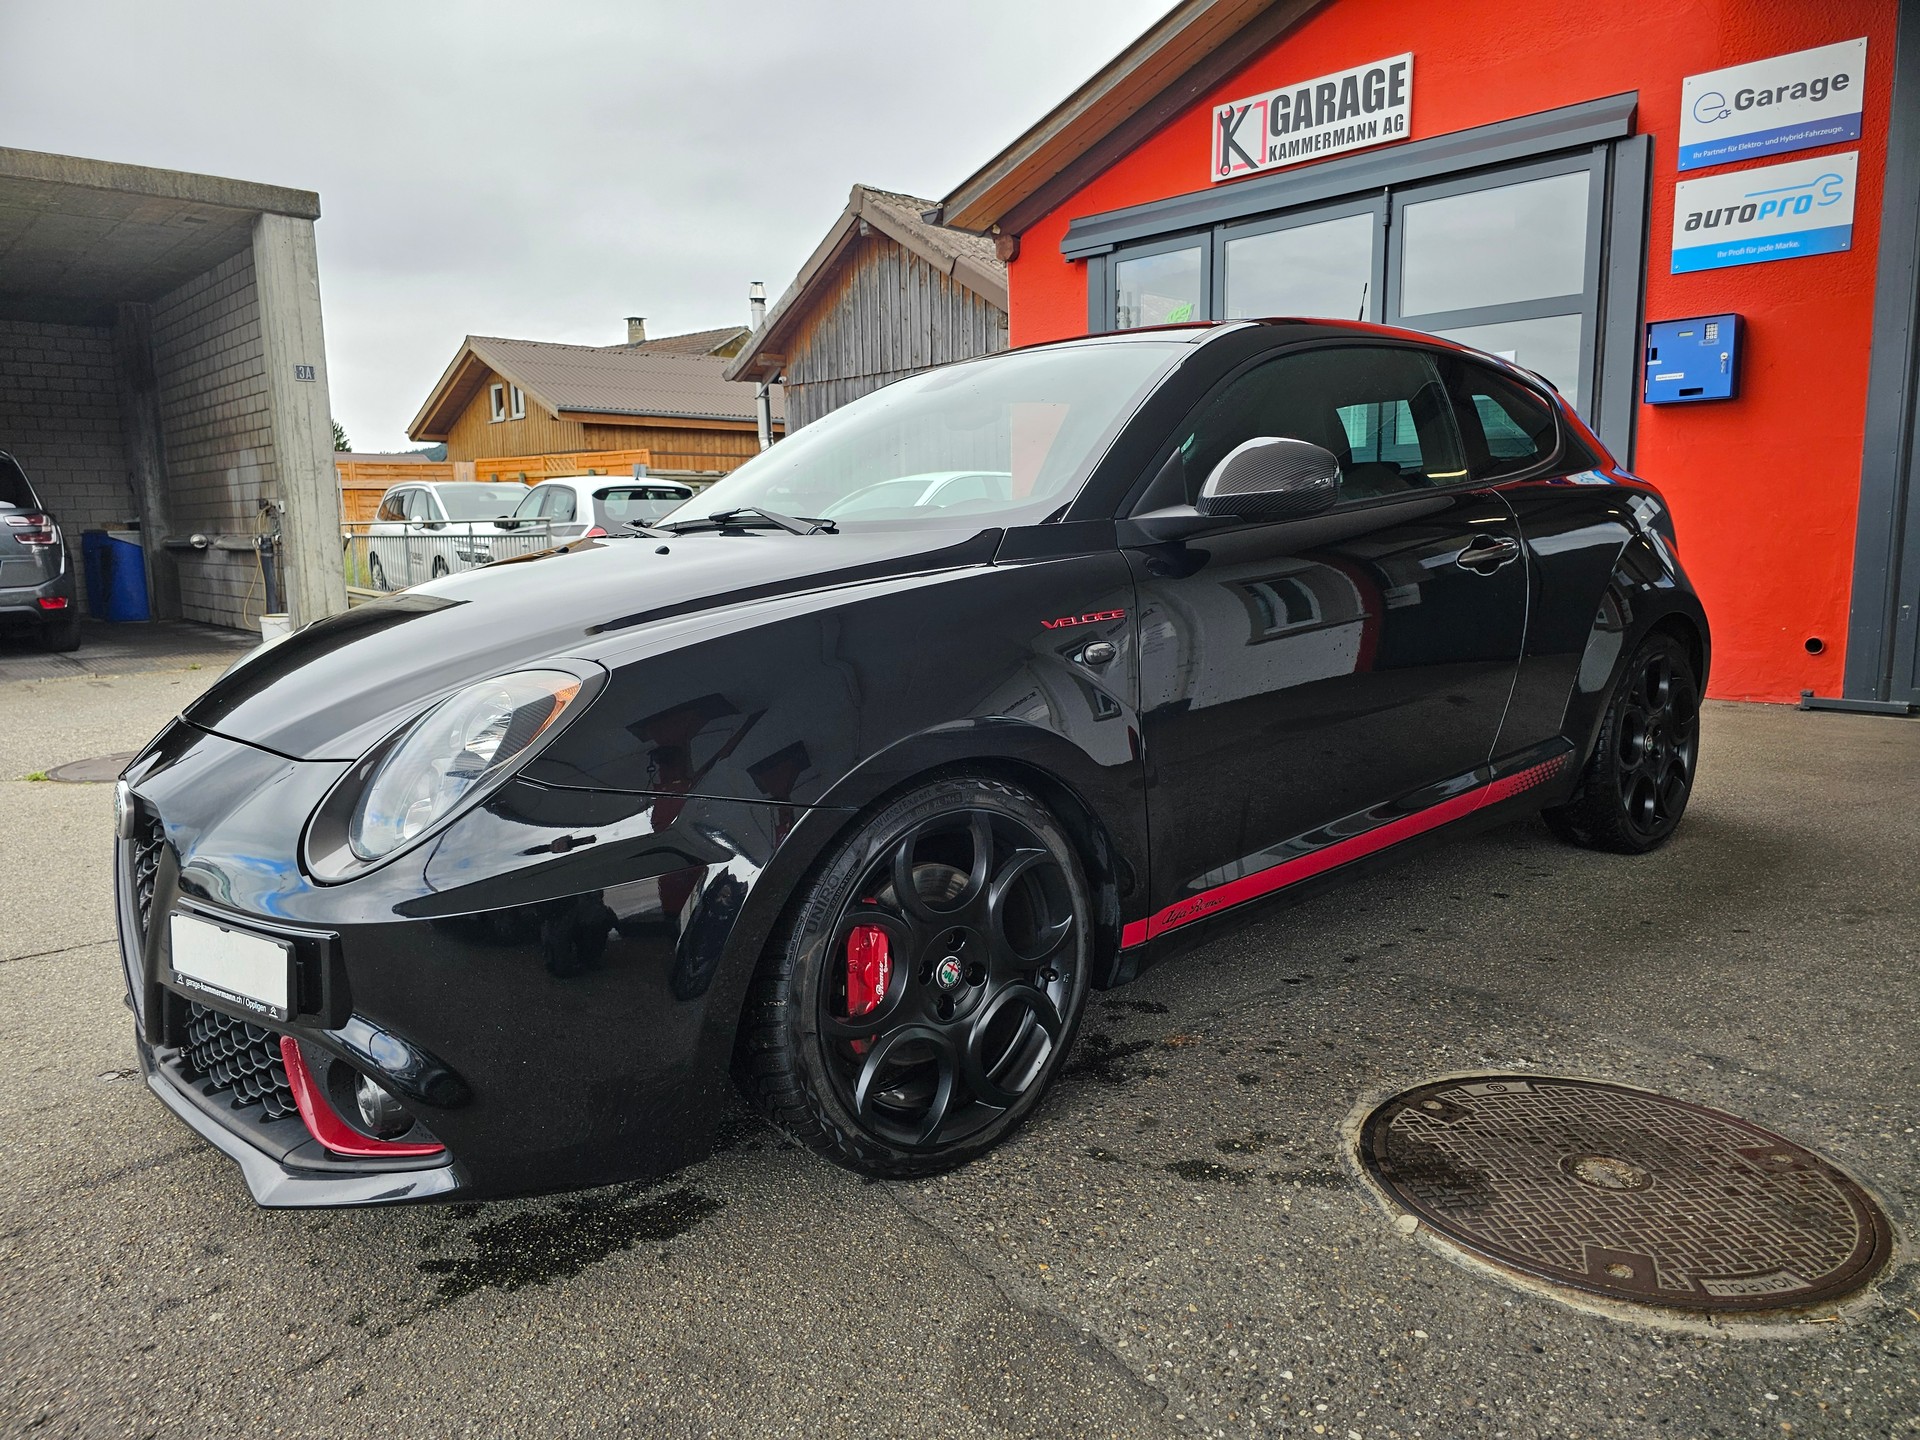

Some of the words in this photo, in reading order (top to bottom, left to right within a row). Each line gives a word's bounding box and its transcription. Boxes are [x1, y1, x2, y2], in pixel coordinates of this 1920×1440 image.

[1269, 61, 1406, 137] GARAGE
[1734, 73, 1850, 111] Garage
[1268, 120, 1378, 163] KAMMERMANN
[1382, 113, 1404, 136] AG
[1692, 151, 1703, 159] Ihr
[1703, 145, 1728, 158] Partner
[1728, 143, 1738, 152] für
[1738, 138, 1764, 151] Elektro-
[1765, 135, 1779, 146] und
[1779, 126, 1844, 145] Hybrid-Fahrzeuge.
[1717, 249, 1728, 259] Ihr
[1728, 246, 1745, 258] Profi
[1746, 244, 1757, 254] für
[1757, 242, 1774, 255] jede
[1775, 240, 1801, 251] Marke.
[299, 366, 312, 379] 3A
[1041, 608, 1126, 629] VELOCE
[1161, 907, 1188, 928] Alfa
[1188, 895, 1226, 916] Romeo
